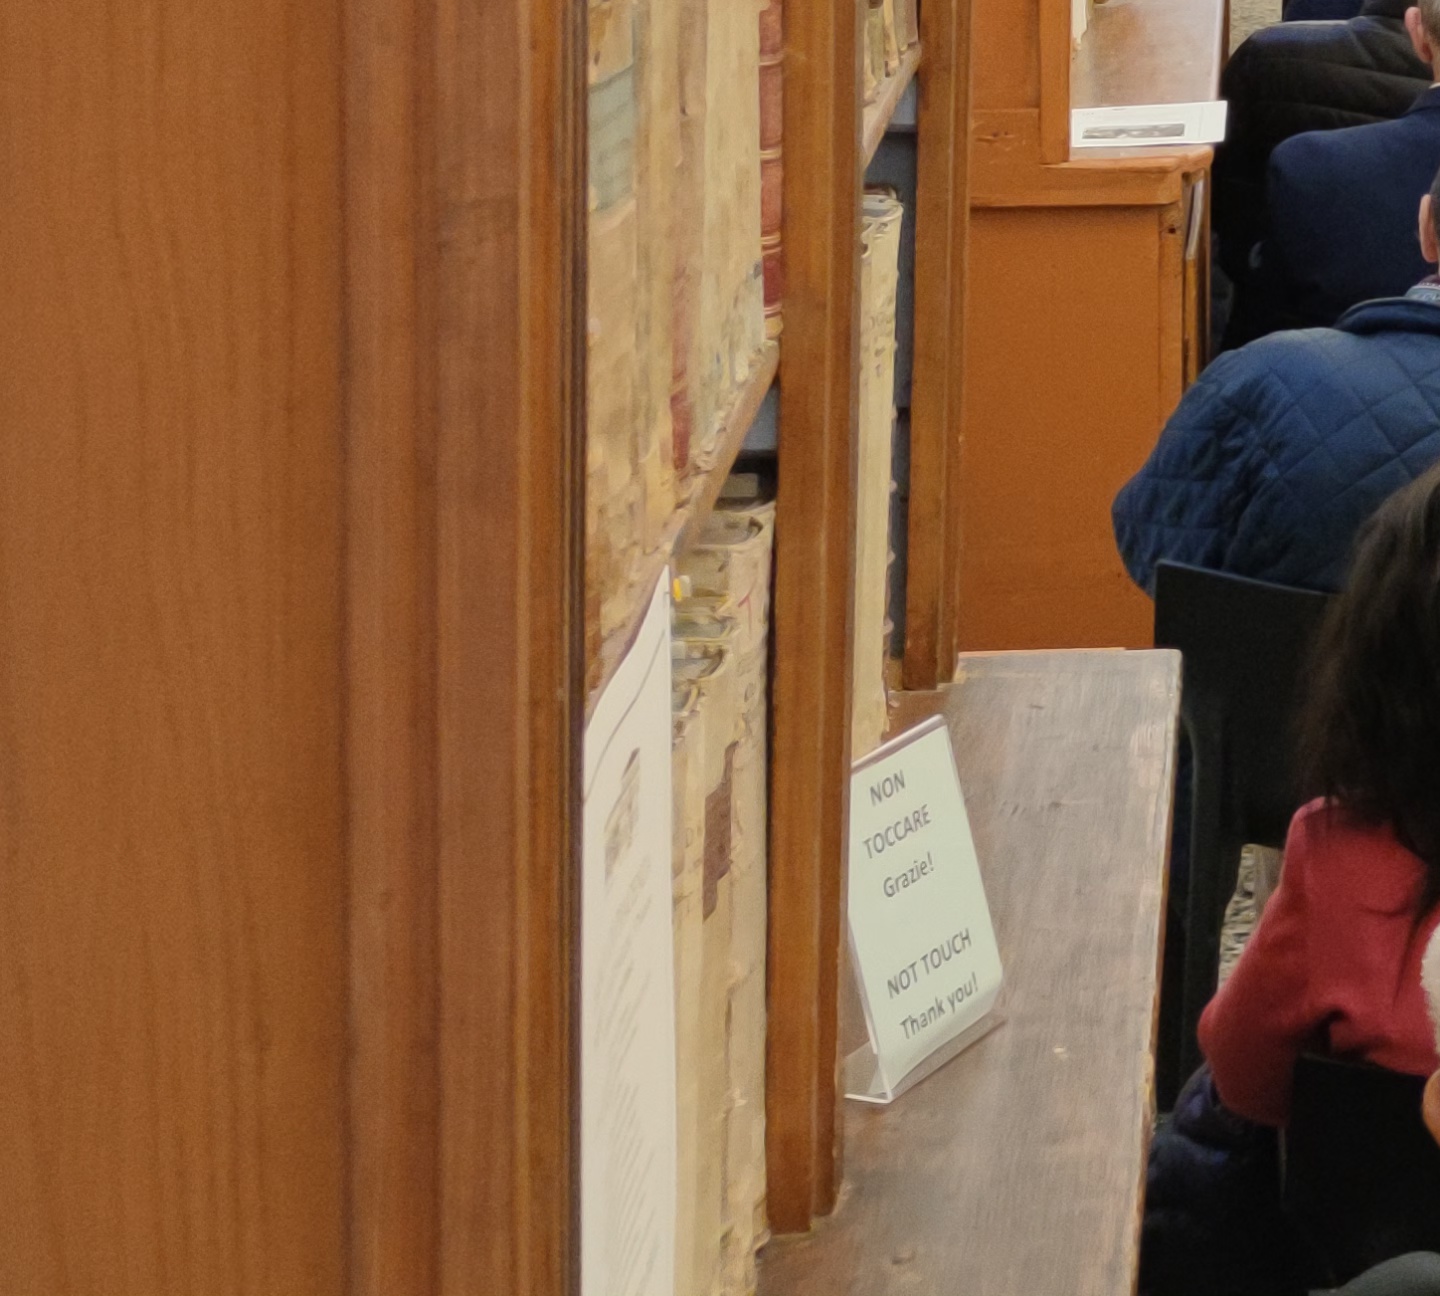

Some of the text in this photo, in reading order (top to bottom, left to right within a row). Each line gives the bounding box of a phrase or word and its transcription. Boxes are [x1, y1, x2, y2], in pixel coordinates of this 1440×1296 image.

[869, 769, 907, 806] NON
[863, 804, 931, 859] TOCCARE
[883, 851, 935, 899] Grazie!
[886, 927, 973, 1000] NOT TOUCH
[899, 971, 979, 1041] Thank you!
